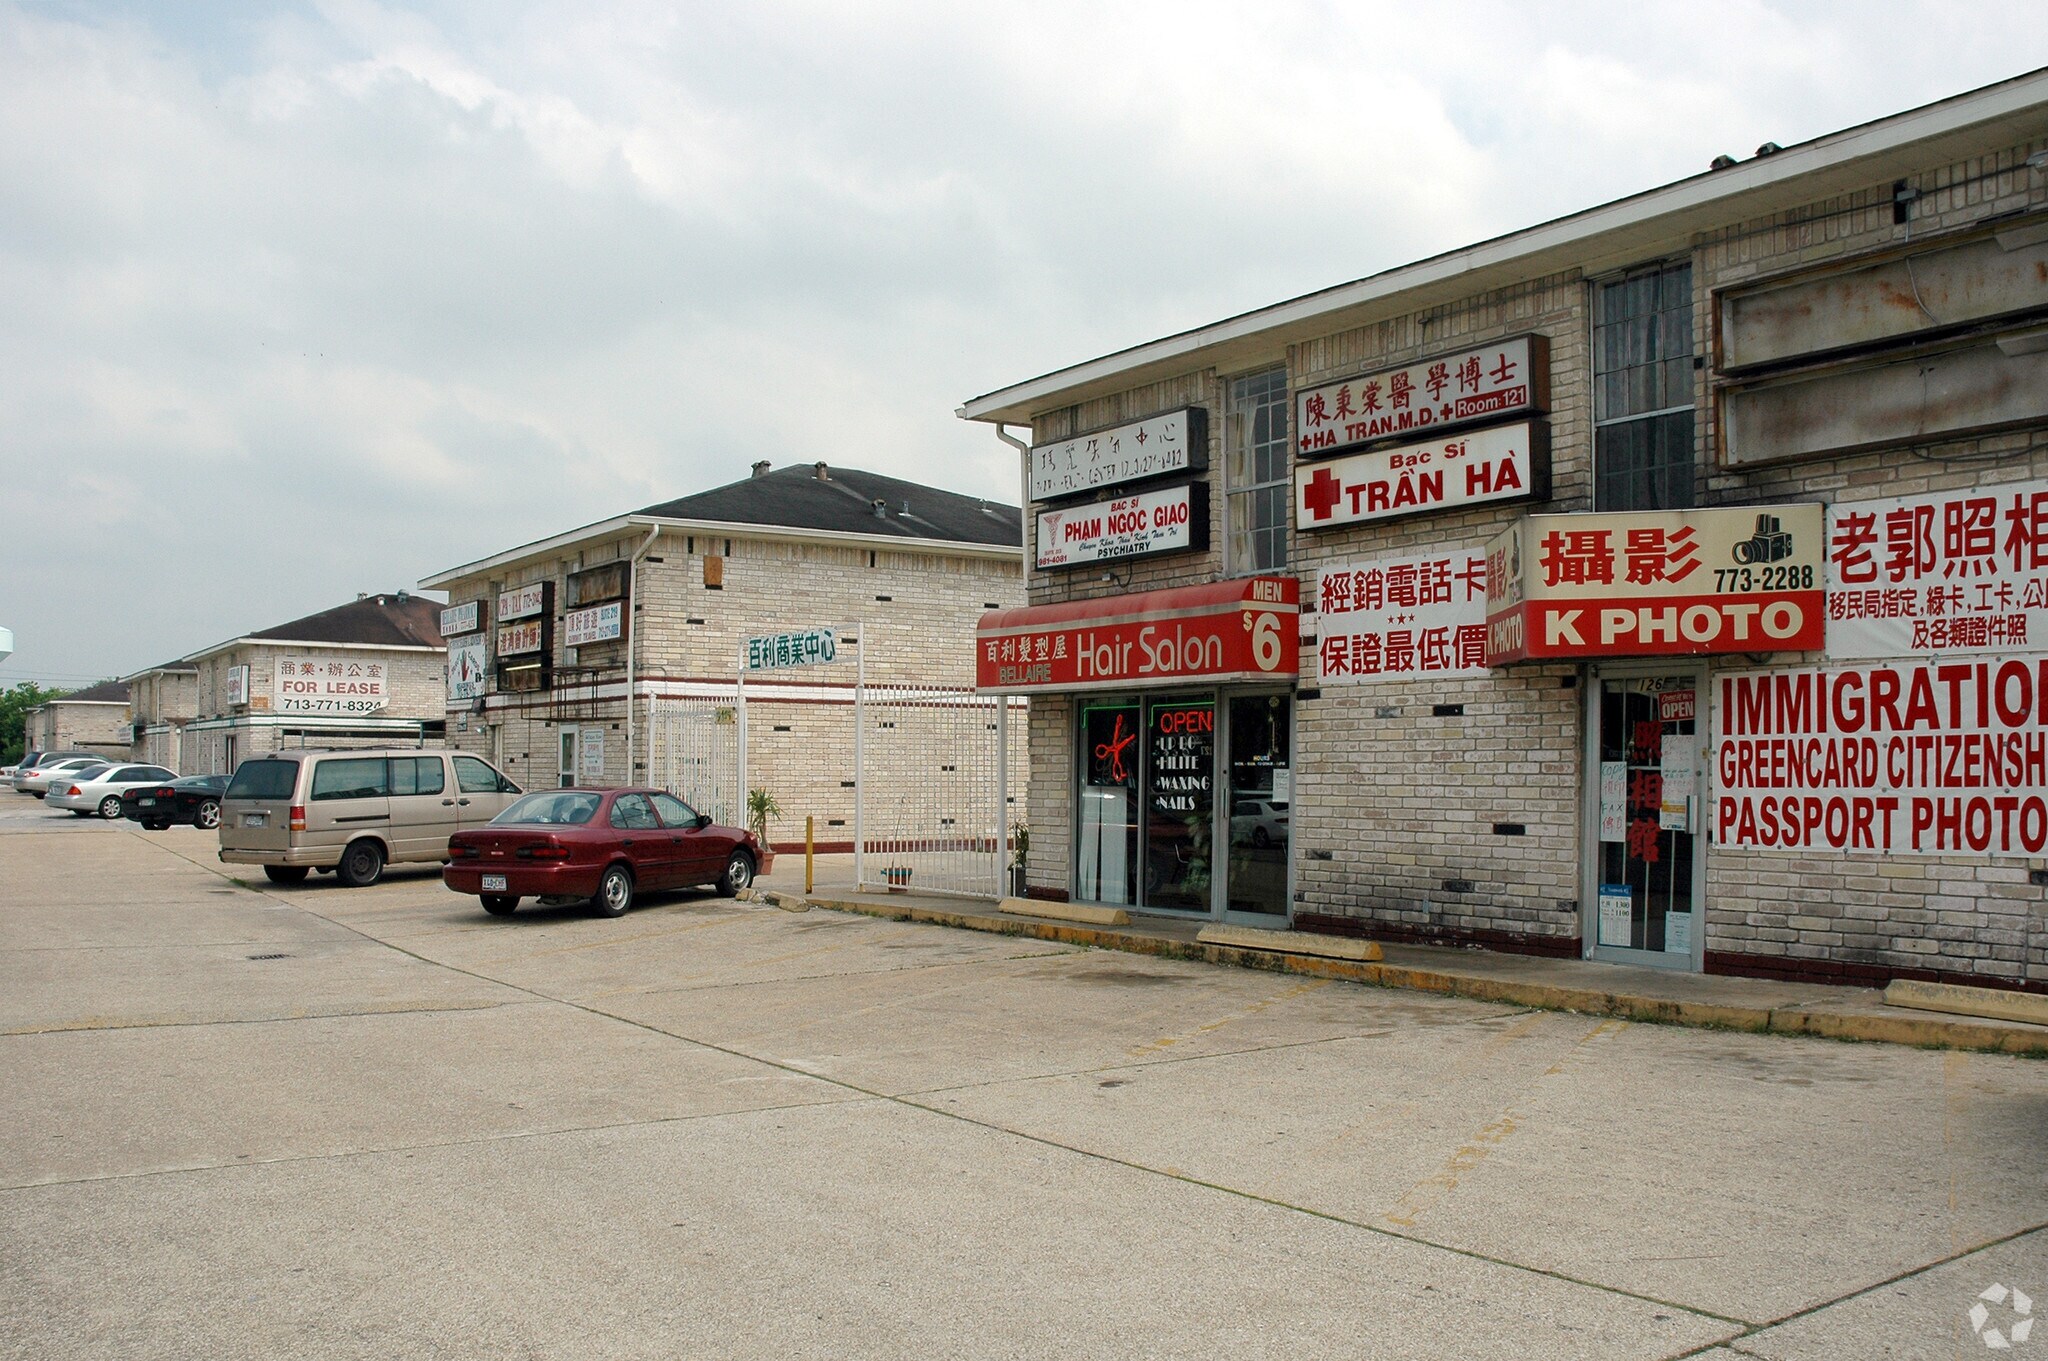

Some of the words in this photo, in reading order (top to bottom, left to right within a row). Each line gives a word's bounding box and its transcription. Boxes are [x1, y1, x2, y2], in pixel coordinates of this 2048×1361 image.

[1313, 430, 1337, 449] HA
[1345, 468, 1444, 515] TRẦN
[1466, 450, 1521, 497] HÀ
[1154, 502, 1188, 528] GIAO
[1097, 541, 1151, 558] PSYCHIATRY
[1831, 492, 2048, 584] 老郭照相
[1539, 525, 1702, 587] 攝影
[1253, 580, 1282, 602] MEN
[1321, 557, 1486, 614] 經銷電話卡
[1713, 565, 1814, 593] 773-2288
[1829, 578, 2048, 621] 移民局指定,綠卡,工卡,公
[1494, 613, 1523, 653] PHOTO
[1545, 610, 1586, 646] K
[1601, 601, 1804, 645] PHOTO
[1911, 613, 2028, 650] 及各類證件照
[749, 630, 836, 668] 百利商業中心
[985, 634, 1068, 663] 百利髮型屋
[1077, 633, 1132, 677] Hair
[1138, 624, 1222, 673] Salon
[1319, 624, 1486, 678] 保證最低價
[282, 681, 317, 693] FOR
[327, 682, 380, 694] LEASE
[1000, 663, 1051, 684] BELLAIRE
[1160, 711, 1213, 734] OPEN
[1662, 702, 1694, 719] OPEN
[1160, 756, 1199, 770] HILITE
[1720, 737, 1878, 789] GREENCARD
[1159, 776, 1210, 791] WAXING
[1159, 796, 1195, 811] NAILS
[1602, 803, 1623, 814] FAX
[1719, 796, 1899, 848] PASSPORT
[1911, 795, 2048, 852] PHOTO
